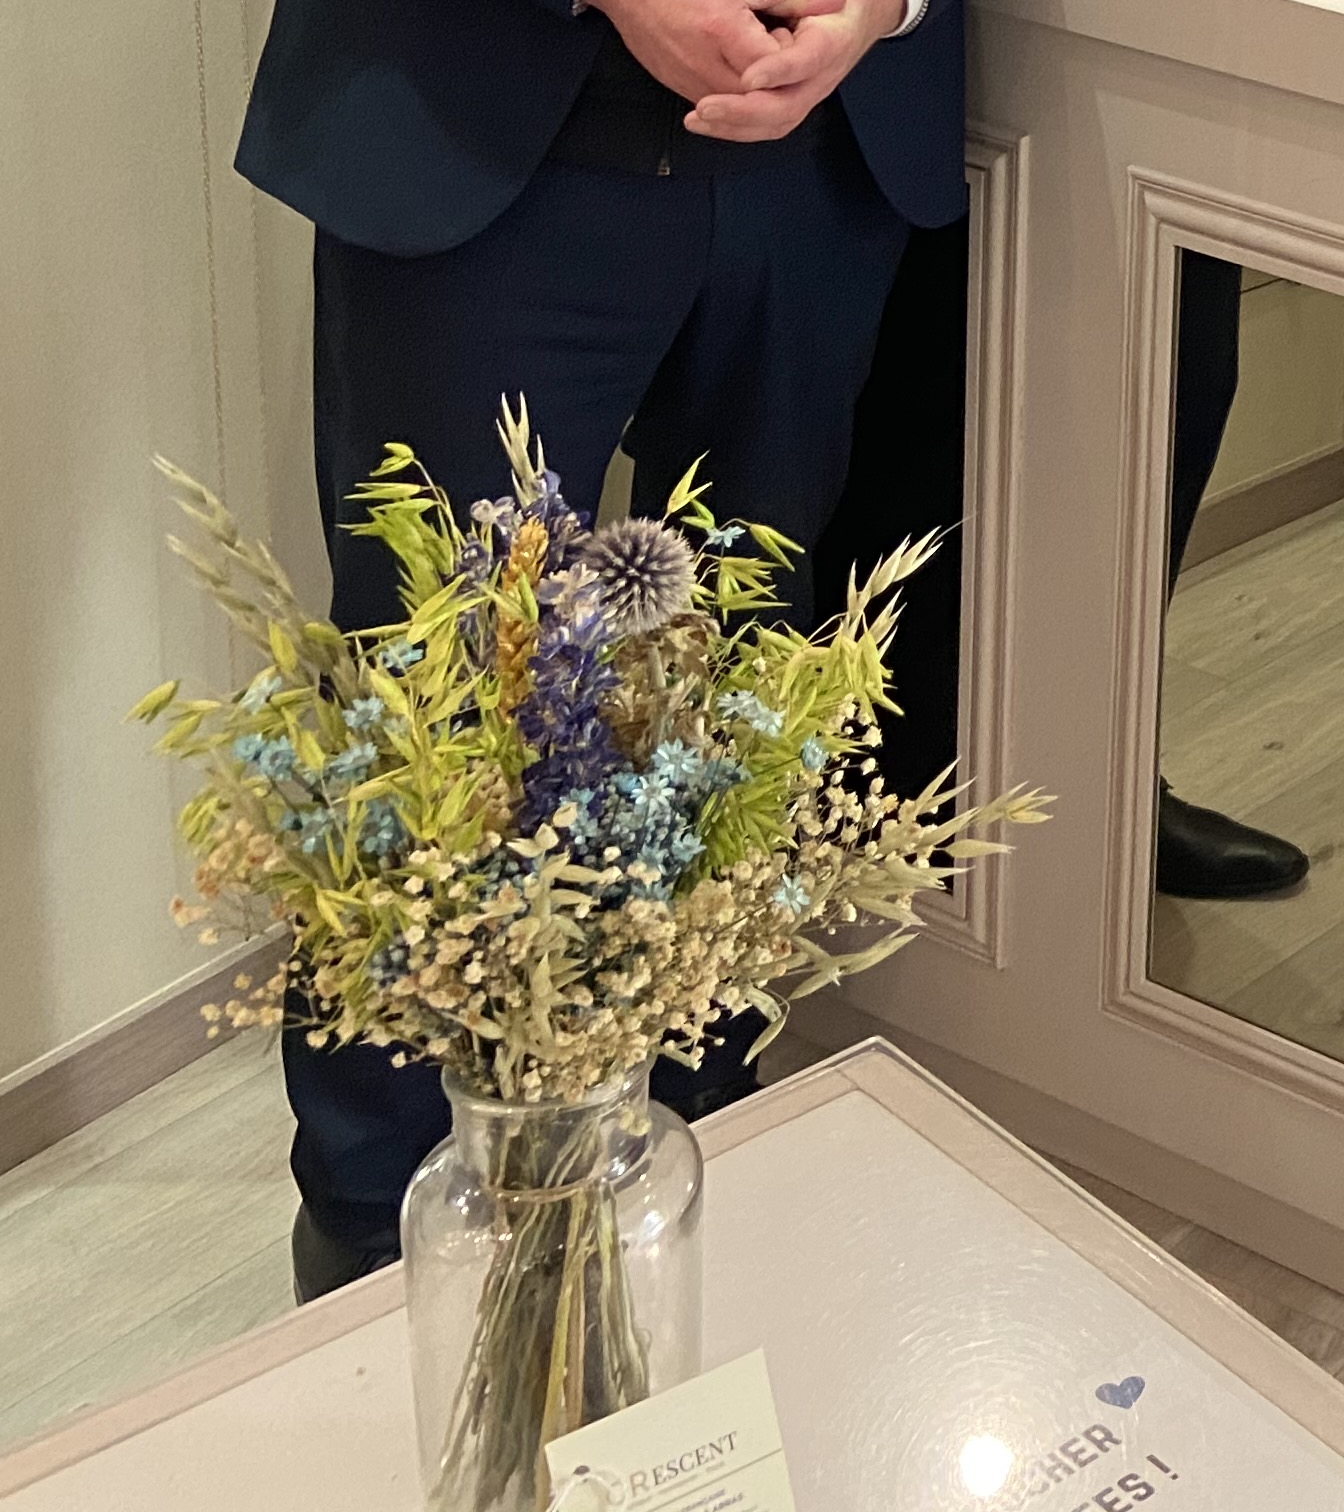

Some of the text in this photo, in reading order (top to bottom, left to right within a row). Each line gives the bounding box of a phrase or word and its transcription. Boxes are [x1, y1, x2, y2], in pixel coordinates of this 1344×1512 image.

[1028, 1423, 1122, 1497] CHER
[1071, 1454, 1179, 1512] ES !
